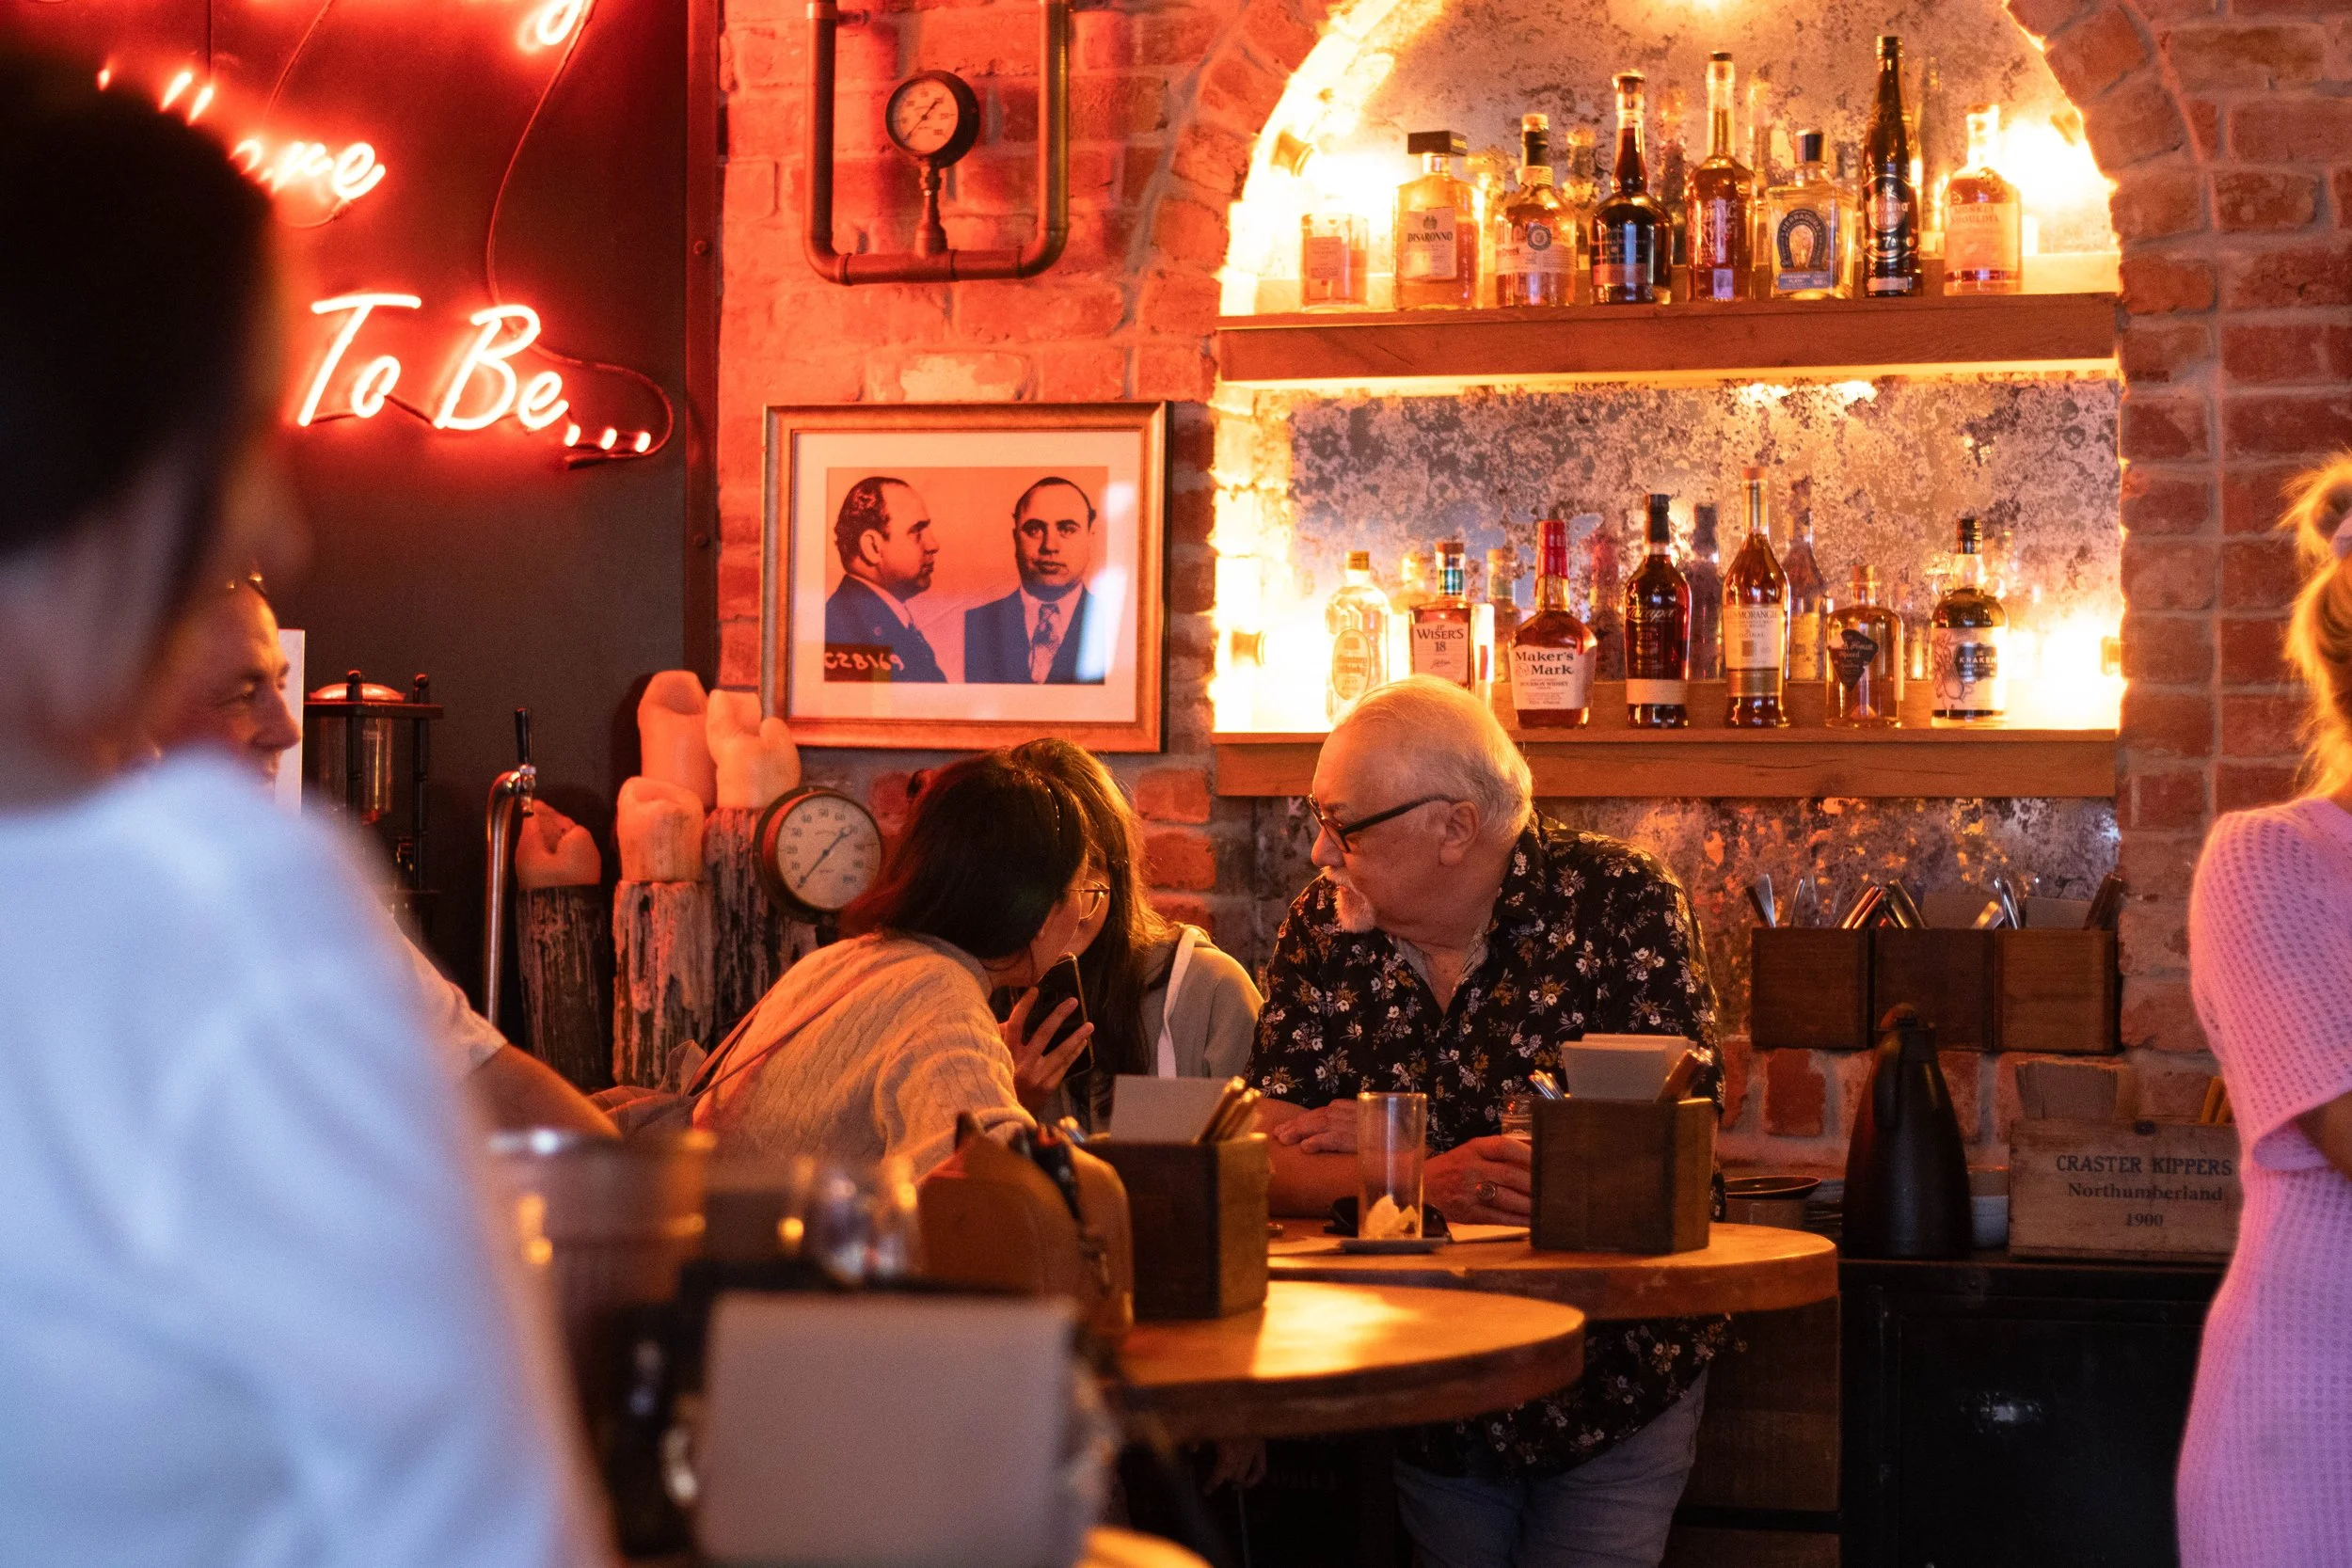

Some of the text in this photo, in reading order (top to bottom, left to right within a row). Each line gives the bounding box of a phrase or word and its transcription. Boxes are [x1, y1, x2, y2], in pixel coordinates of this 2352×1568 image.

[1871, 202, 1909, 212] vana
[1407, 231, 1454, 243] DISARONNO
[297, 293, 422, 427] To
[1724, 610, 1778, 619] LENMORANGIE
[1416, 628, 1464, 640] WISER'S
[1435, 641, 1446, 652] 18
[824, 651, 905, 671] C28169
[1515, 651, 1574, 661] Maker's
[1531, 664, 1574, 674] Mark
[2056, 1154, 2233, 1176] CRASTER KIPPERS
[2068, 1181, 2223, 1201] Northumberland
[2125, 1212, 2164, 1227] 1900
